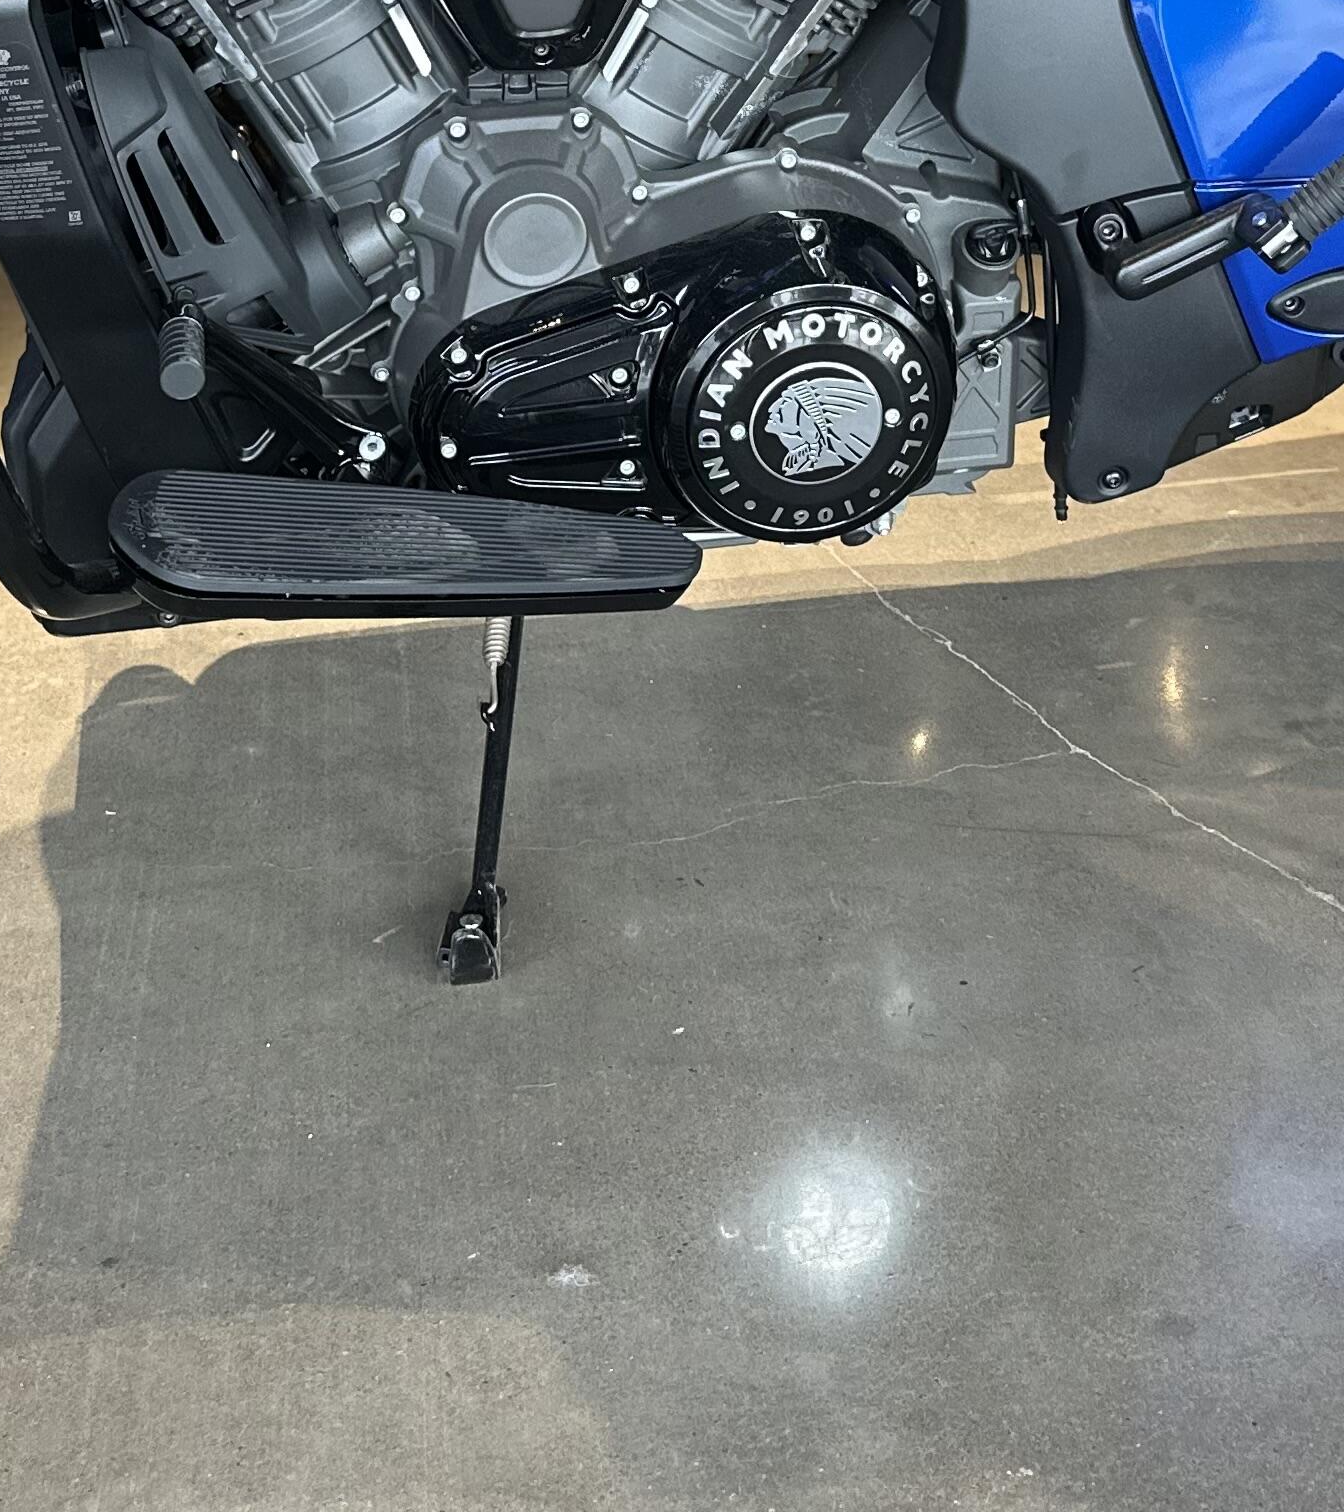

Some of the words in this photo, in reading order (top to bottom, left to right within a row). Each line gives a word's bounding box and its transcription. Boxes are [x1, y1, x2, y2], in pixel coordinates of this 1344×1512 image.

[697, 347, 754, 495] INDIAN
[763, 312, 931, 477] MOTORCYCLE
[770, 498, 856, 526] 1901
